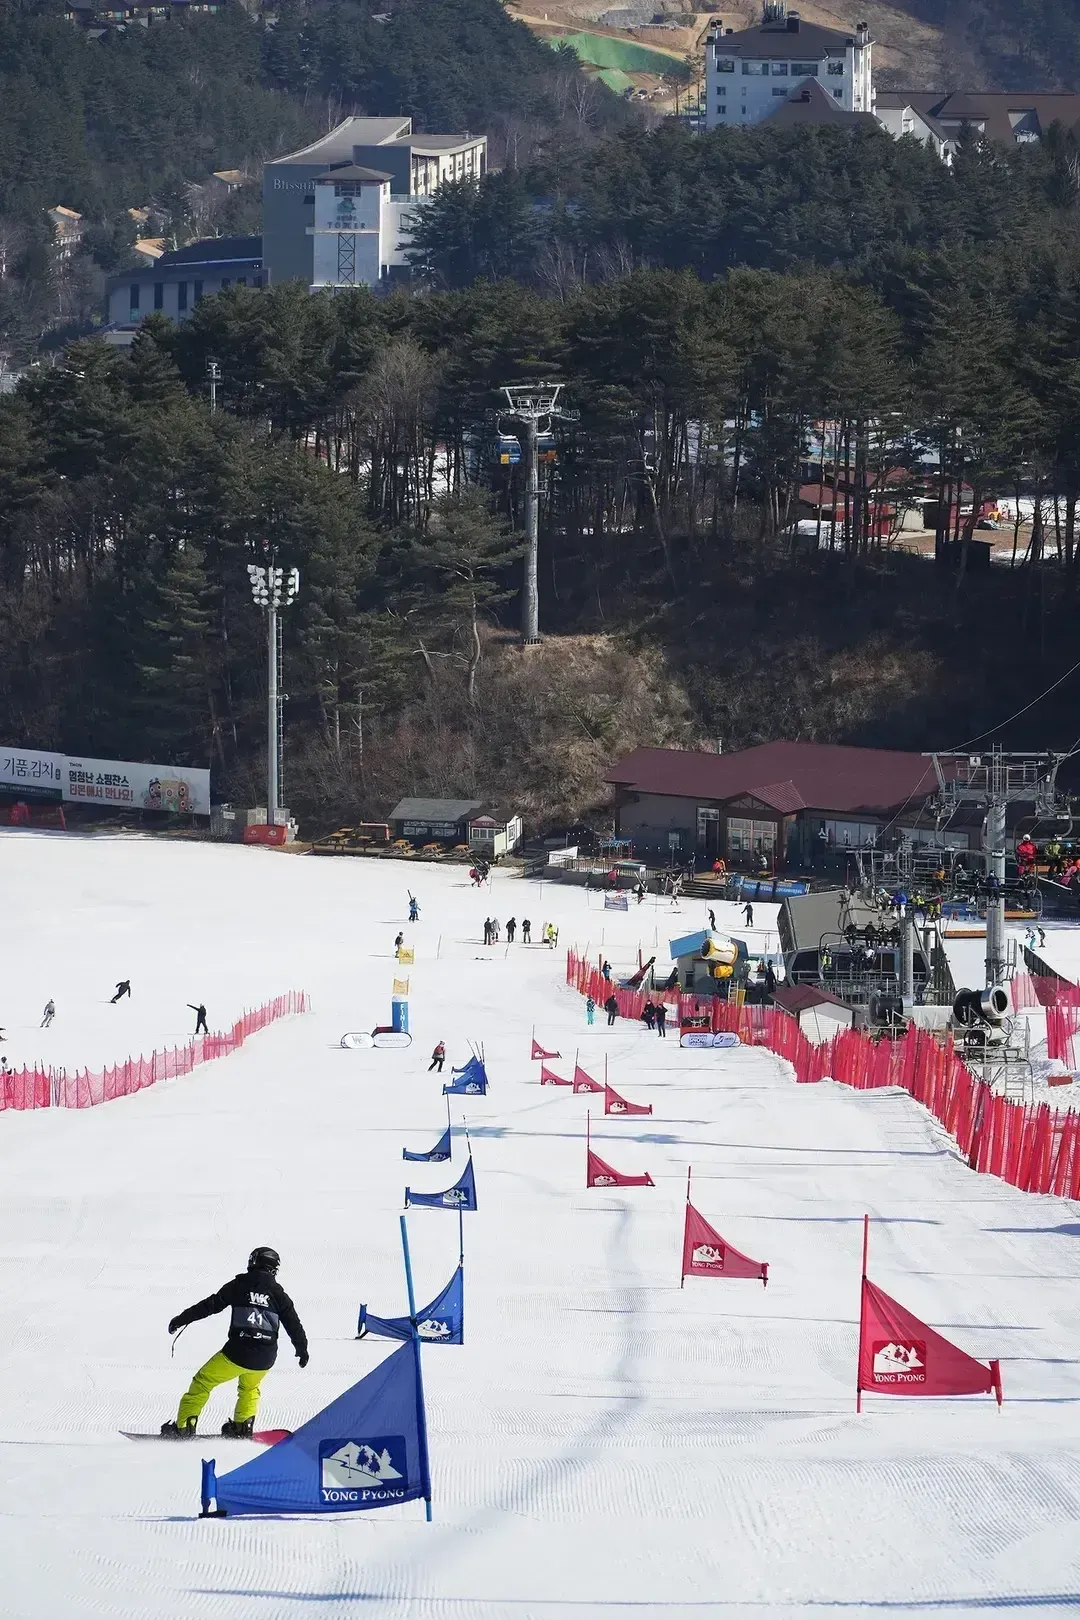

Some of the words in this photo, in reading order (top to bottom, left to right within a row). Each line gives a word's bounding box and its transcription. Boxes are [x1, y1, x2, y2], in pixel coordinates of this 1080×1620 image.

[69, 770, 94, 784] 엄청난
[96, 773, 130, 788] 쇼핑찬스
[69, 784, 104, 798] 티몬에서
[246, 1311, 263, 1326] 41
[873, 1373, 896, 1383] YONG
[896, 1373, 925, 1382] PYONG
[321, 1489, 358, 1502] YONG
[361, 1488, 404, 1500] PYONG
